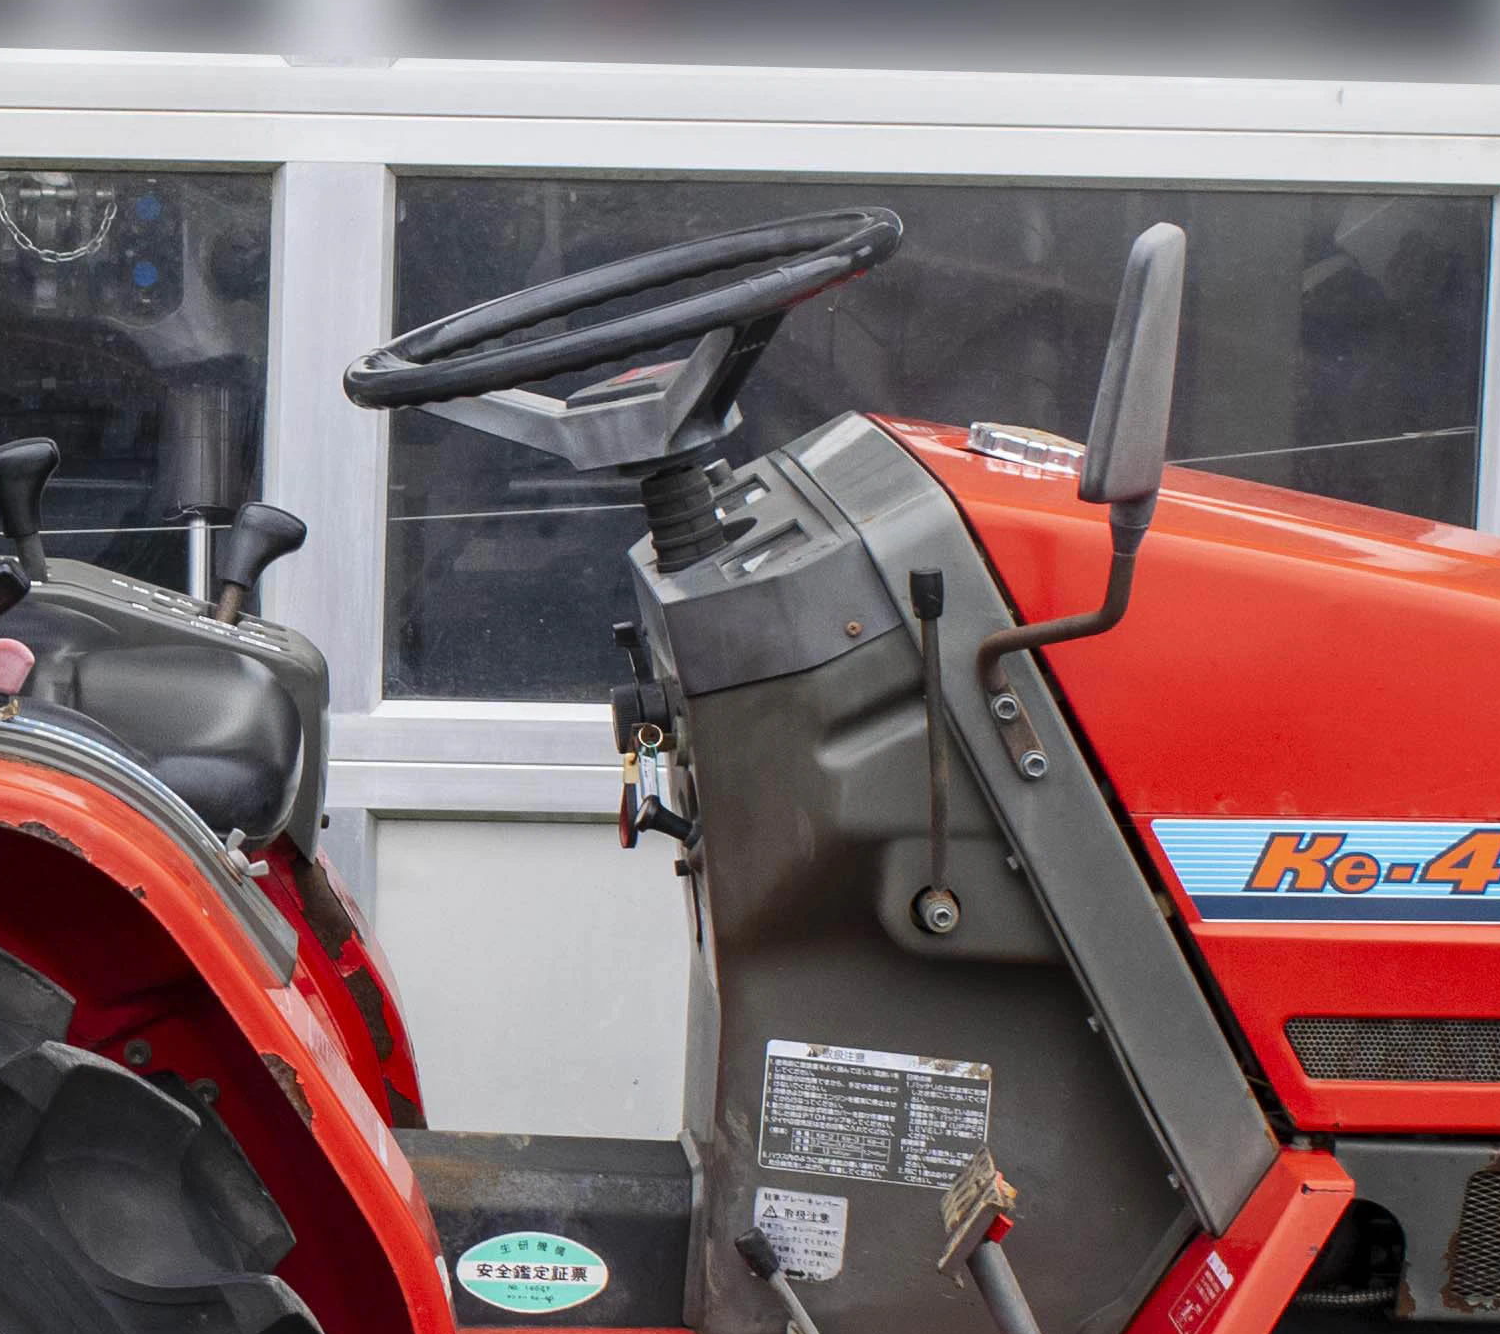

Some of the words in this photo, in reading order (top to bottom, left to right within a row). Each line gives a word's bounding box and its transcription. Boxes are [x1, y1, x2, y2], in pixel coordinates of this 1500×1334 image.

[784, 1208, 831, 1224] 取扱注意
[476, 1263, 589, 1282] 安全鑑定証票
